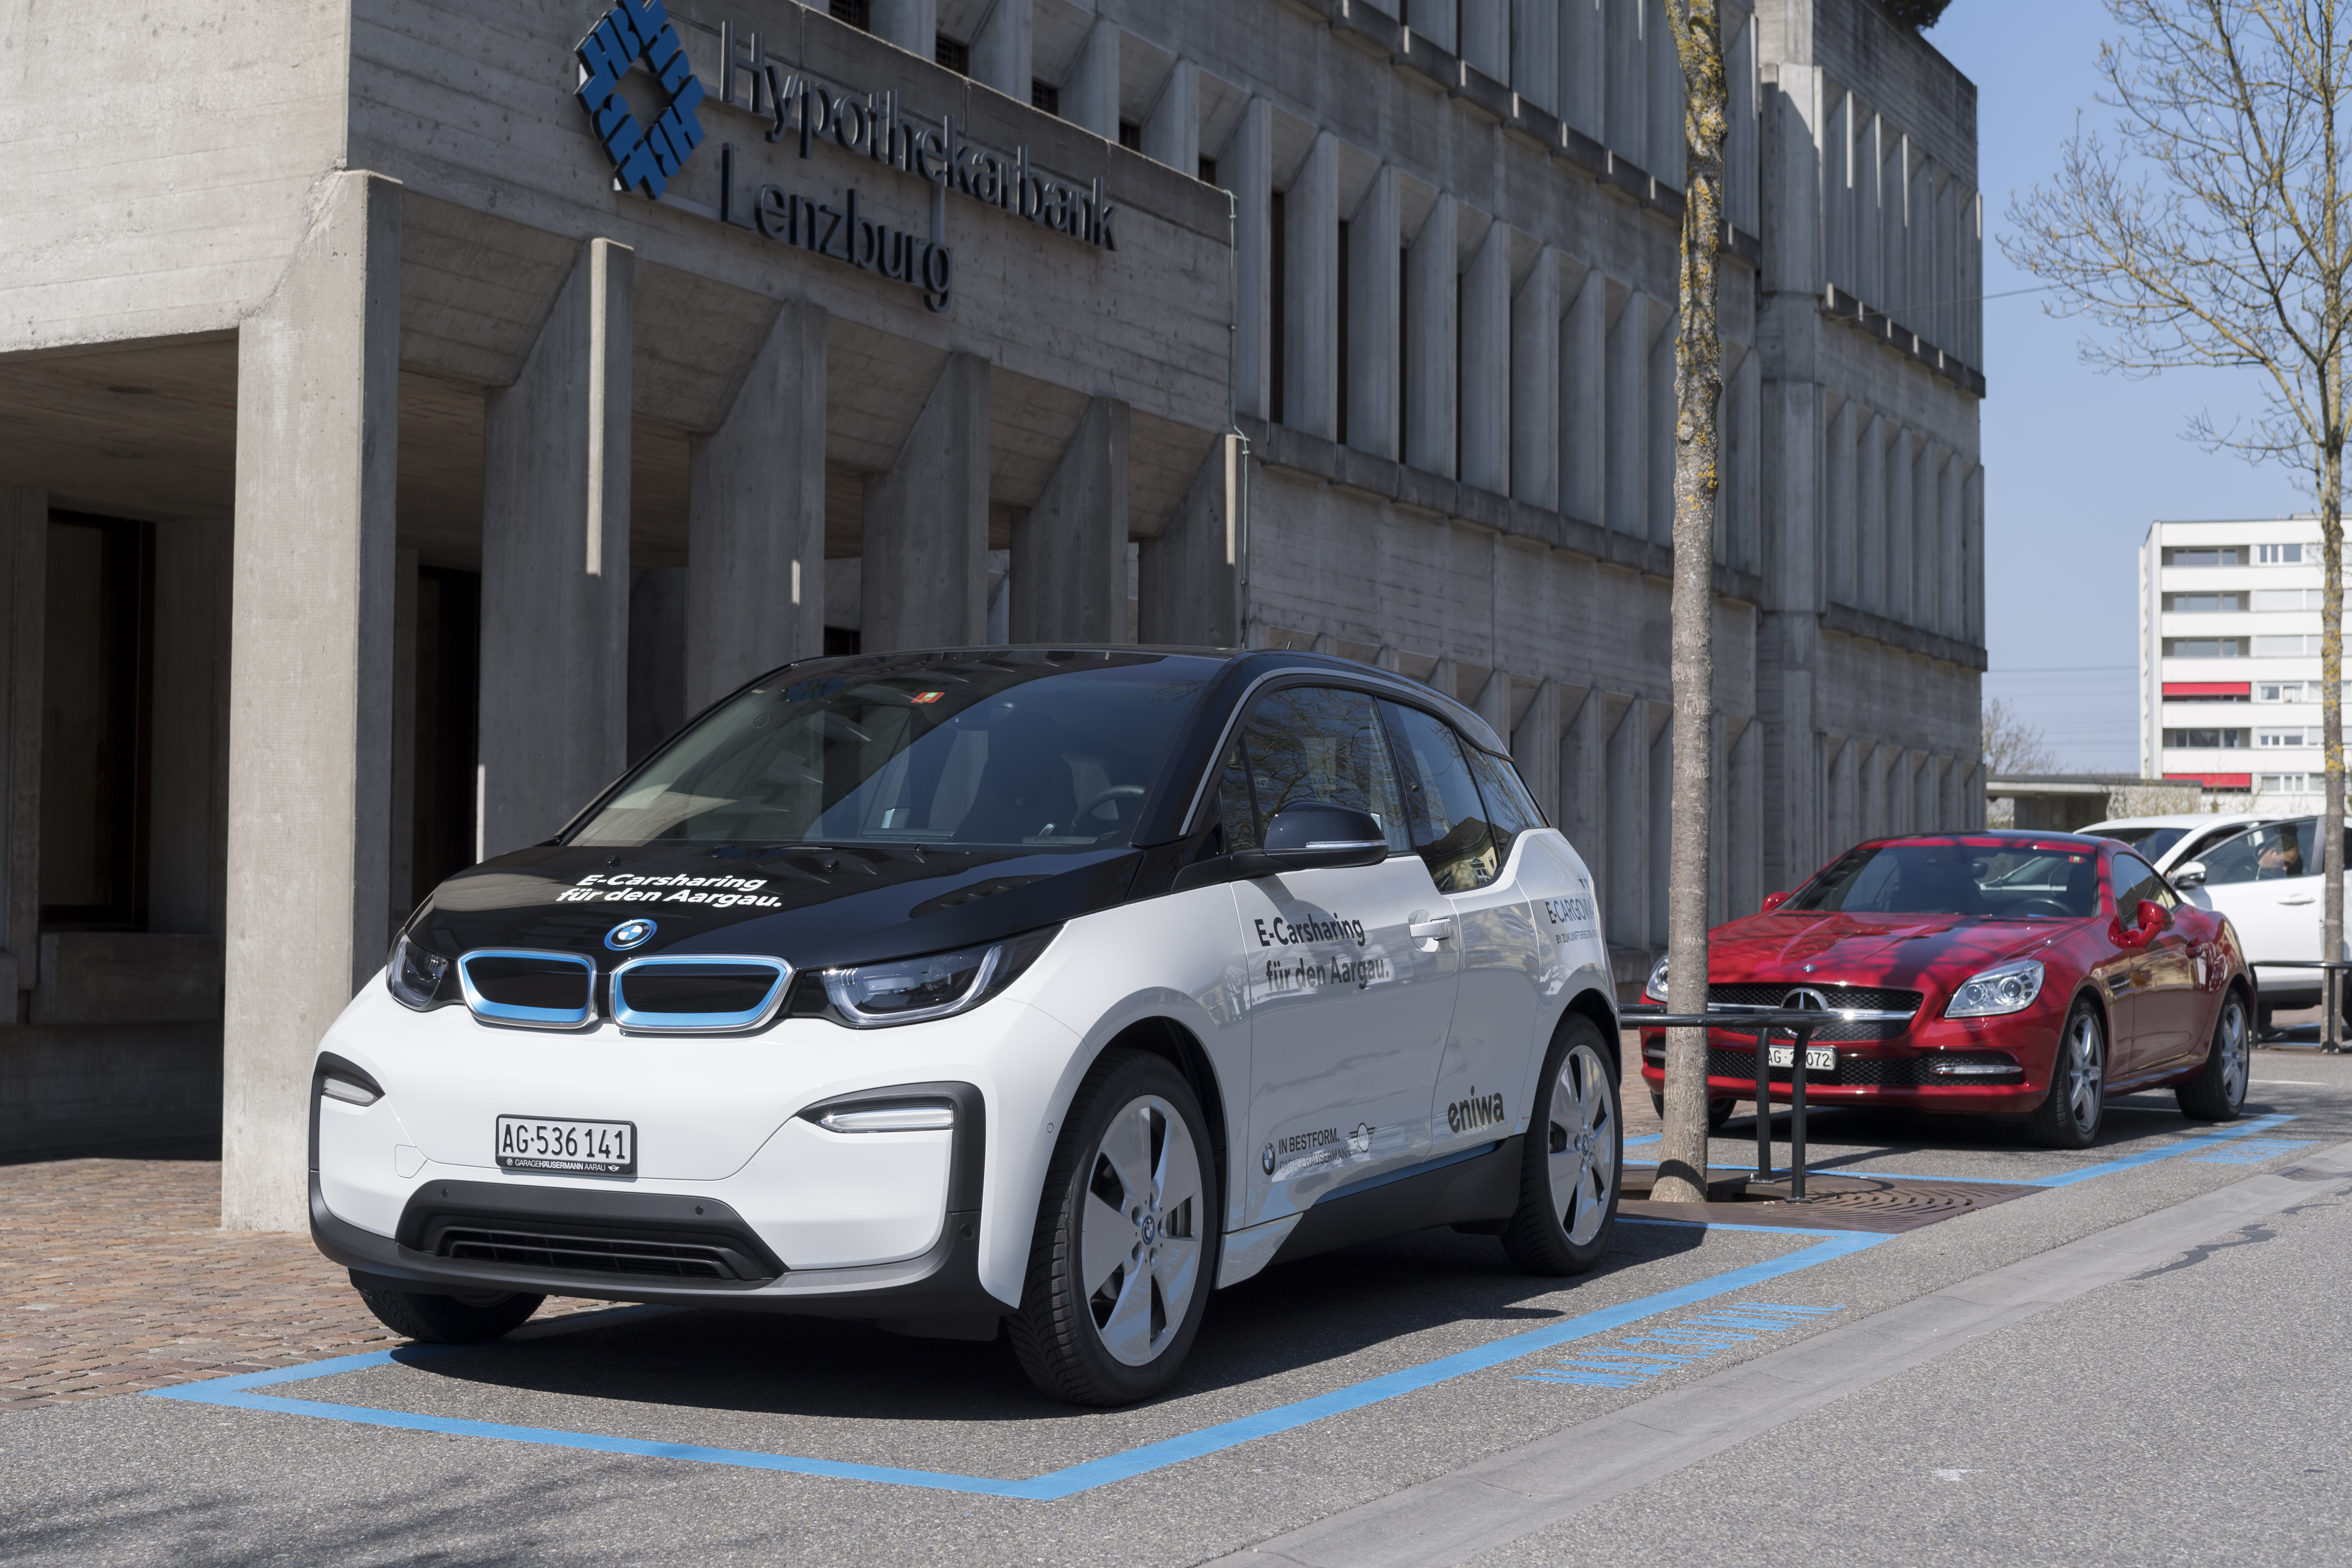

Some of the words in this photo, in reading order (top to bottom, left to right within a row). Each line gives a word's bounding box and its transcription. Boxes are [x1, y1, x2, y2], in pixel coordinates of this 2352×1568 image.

[720, 19, 1118, 252] Hypothekarbank
[720, 142, 953, 313] Lenzburg
[555, 888, 604, 902] für
[604, 888, 662, 903] den
[662, 889, 782, 908] Aargau.
[576, 874, 768, 892] E-Carsharing
[1254, 912, 1366, 947] E-Carsharing
[1555, 934, 1562, 944] BY
[1266, 960, 1291, 991] für
[1295, 957, 1327, 988] den
[1330, 956, 1389, 990] Aargau.
[1448, 1085, 1504, 1133] eniwa
[1279, 1138, 1288, 1155] IN
[1289, 1127, 1340, 1153] BESTFORM.
[584, 1163, 606, 1171] AARAU
